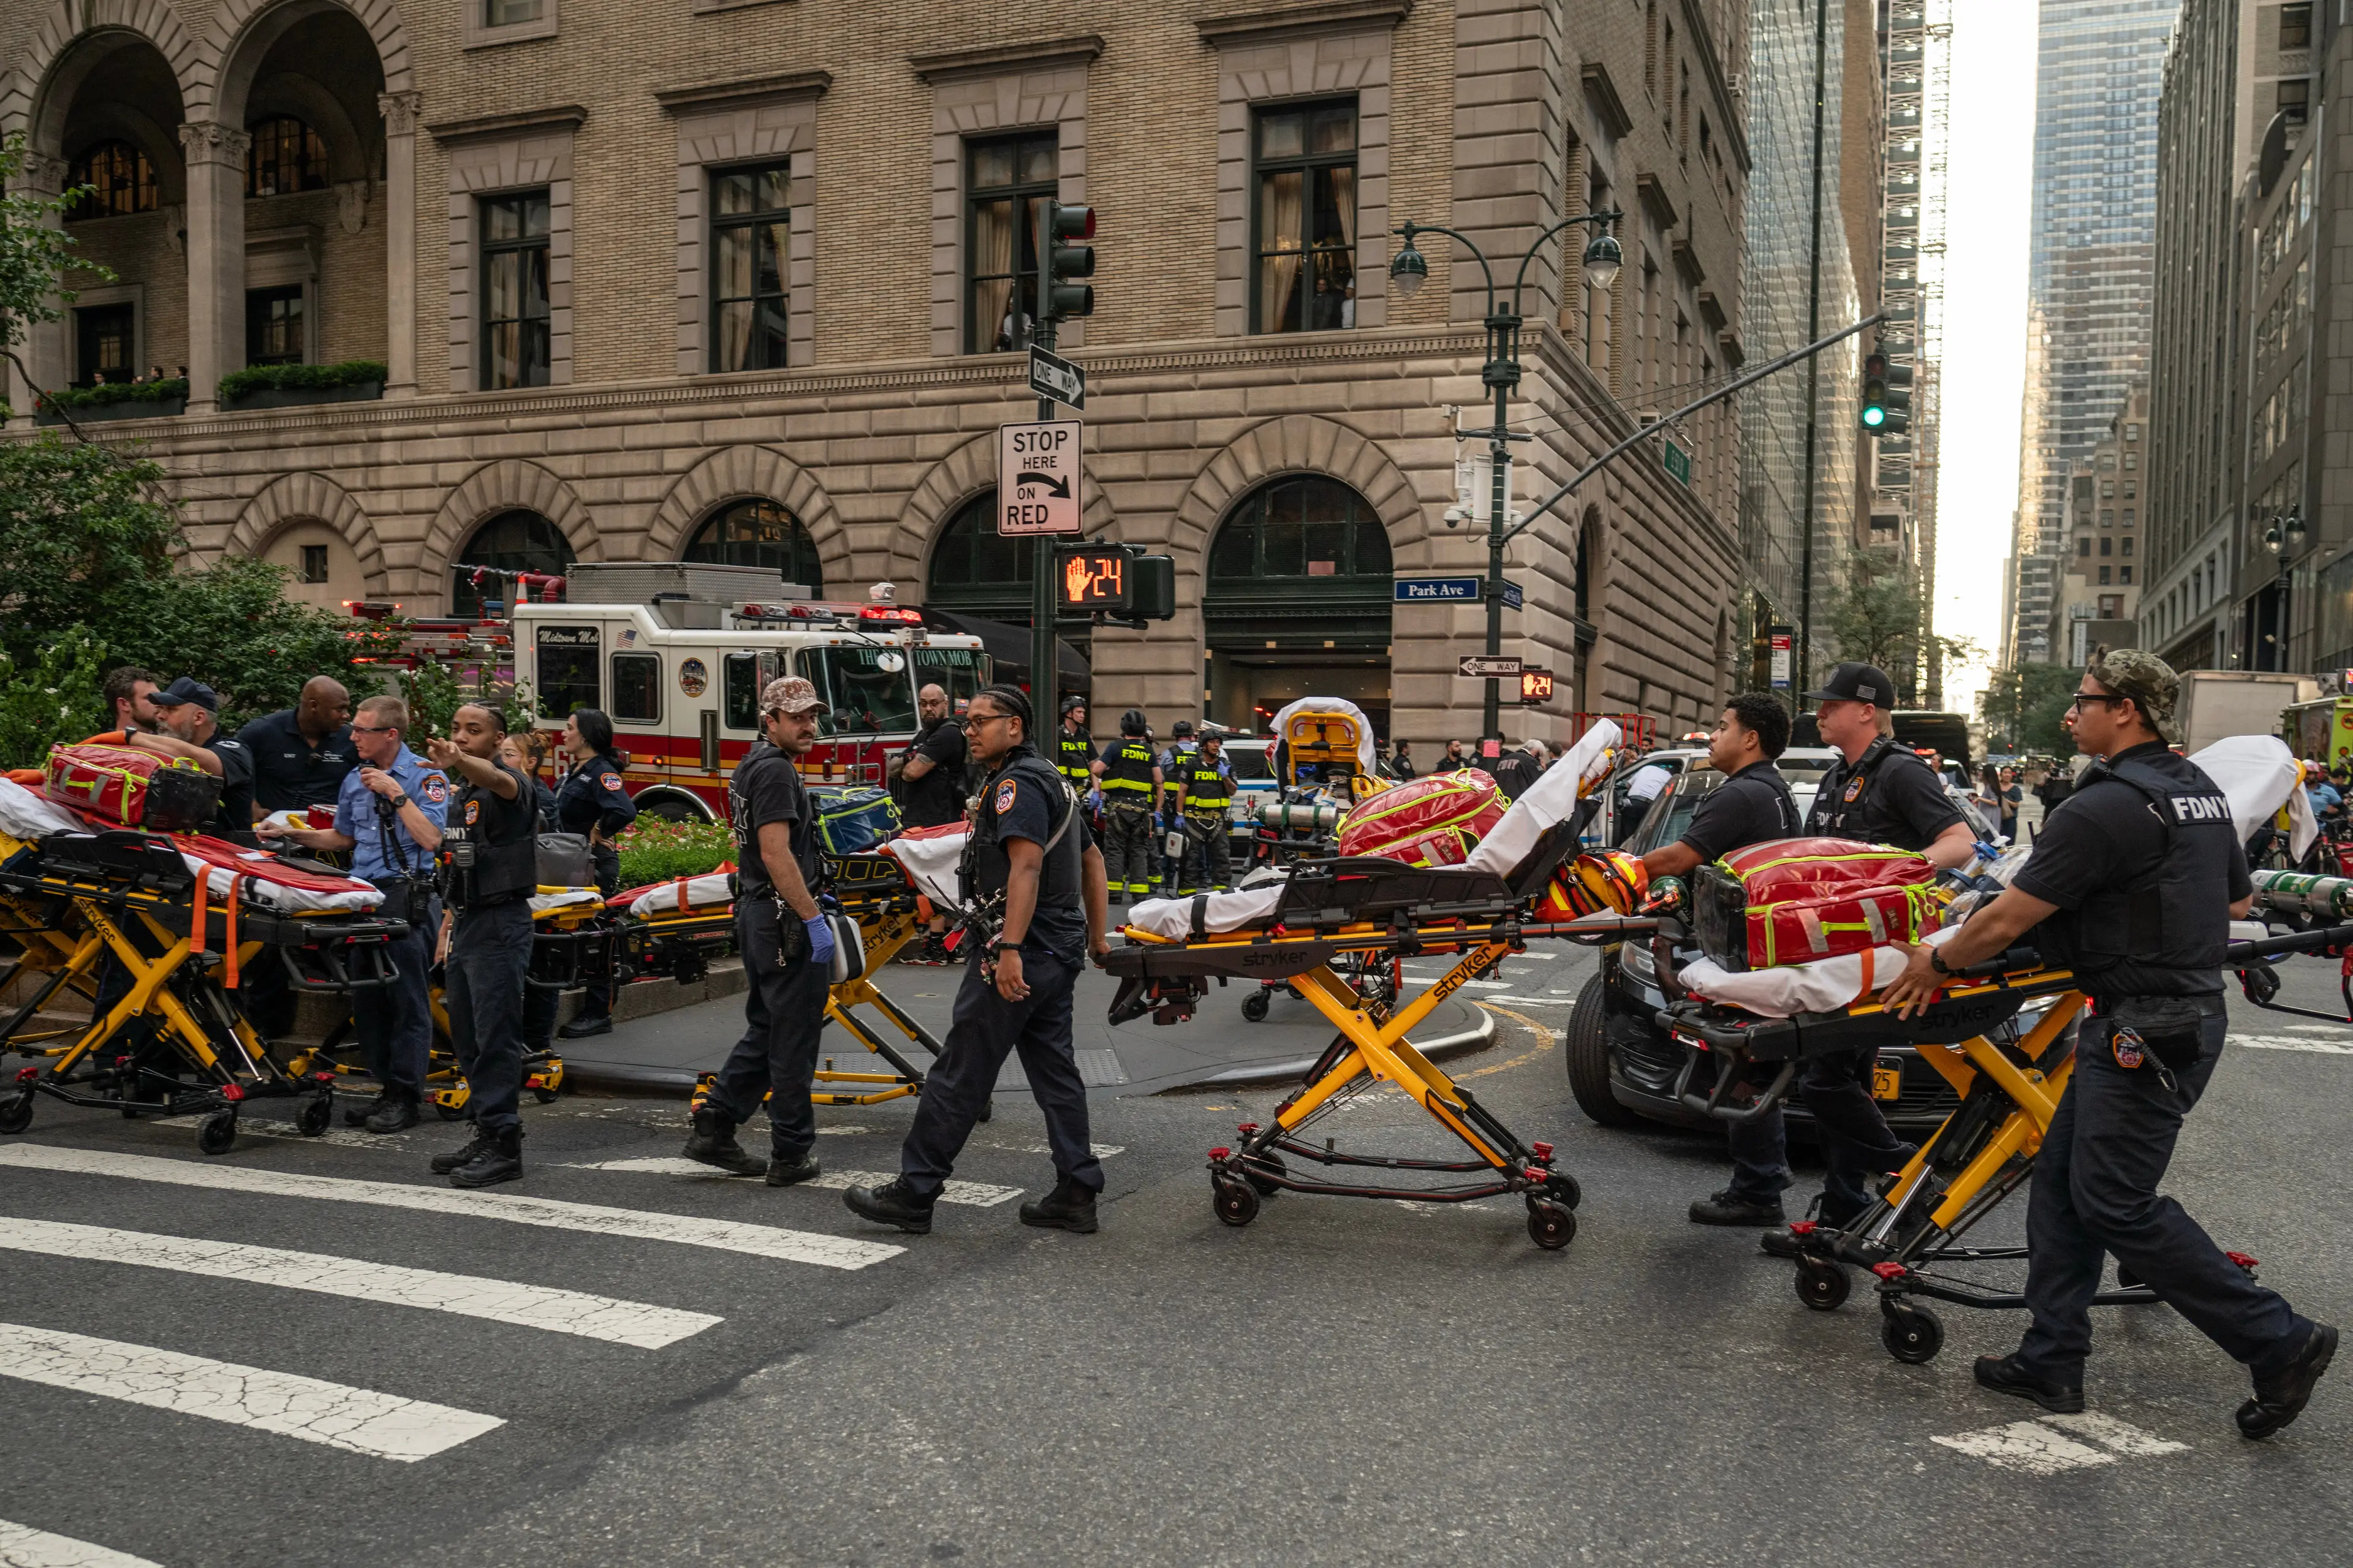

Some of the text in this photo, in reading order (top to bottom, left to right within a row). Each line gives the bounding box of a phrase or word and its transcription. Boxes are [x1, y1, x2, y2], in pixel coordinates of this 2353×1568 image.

[1036, 362, 1077, 394] ONE WAY
[1013, 430, 1067, 452] STOP
[1023, 455, 1058, 469] HERE
[1017, 487, 1036, 500] ON
[1007, 504, 1048, 525] RED
[1093, 558, 1121, 597] 24
[1408, 583, 1464, 596] Park Ave
[539, 630, 577, 643] Midtown
[857, 649, 879, 665] THE
[948, 651, 972, 666] MOB
[1466, 662, 1517, 671] ONE WAY
[1535, 676, 1552, 695] 24
[1122, 748, 1151, 762] FDNY
[2171, 797, 2229, 820] FDNY
[1242, 950, 1308, 966] stryker
[1434, 947, 1491, 1003] stryker
[1919, 1005, 1995, 1031] stryker
